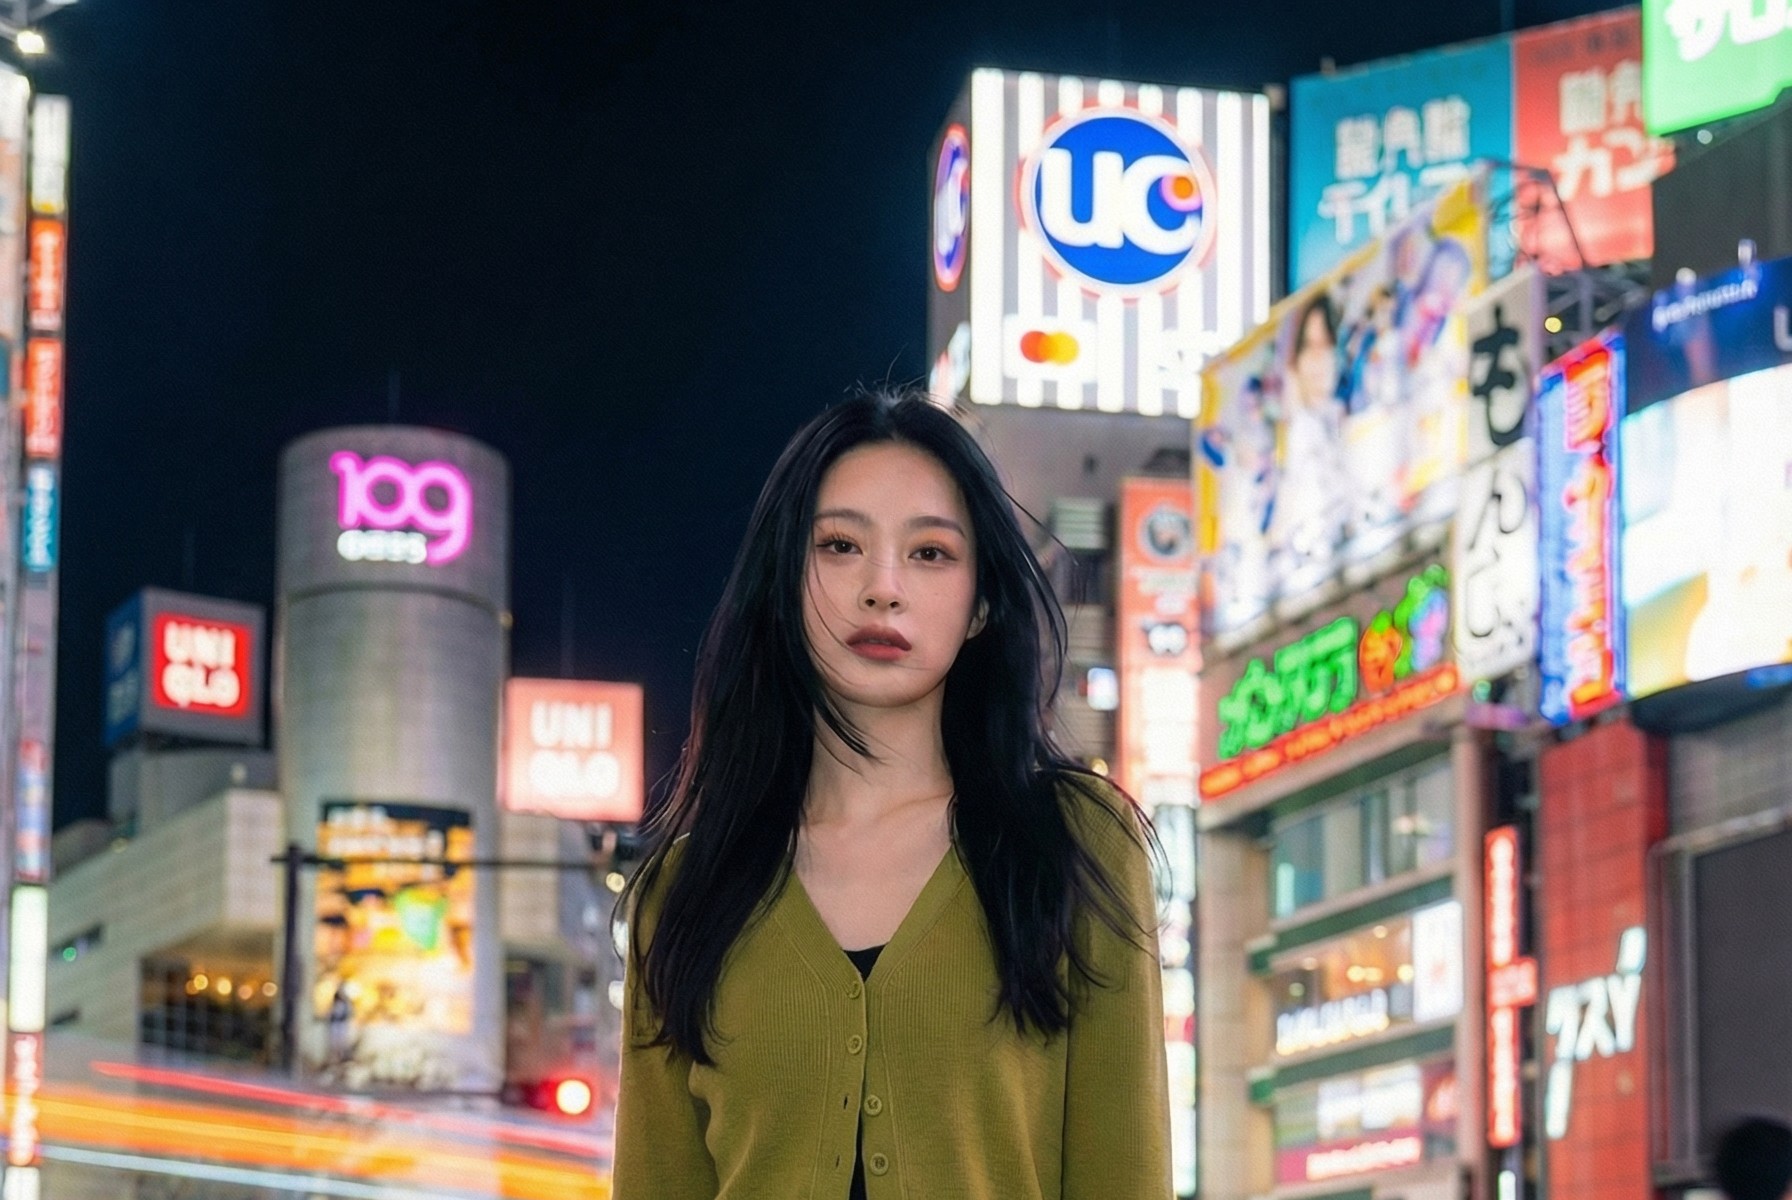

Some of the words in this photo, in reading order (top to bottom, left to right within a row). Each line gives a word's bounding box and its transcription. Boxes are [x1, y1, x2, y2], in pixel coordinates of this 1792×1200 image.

[329, 451, 473, 566] 109
[163, 619, 237, 670] UNI
[531, 699, 613, 750] UNI
